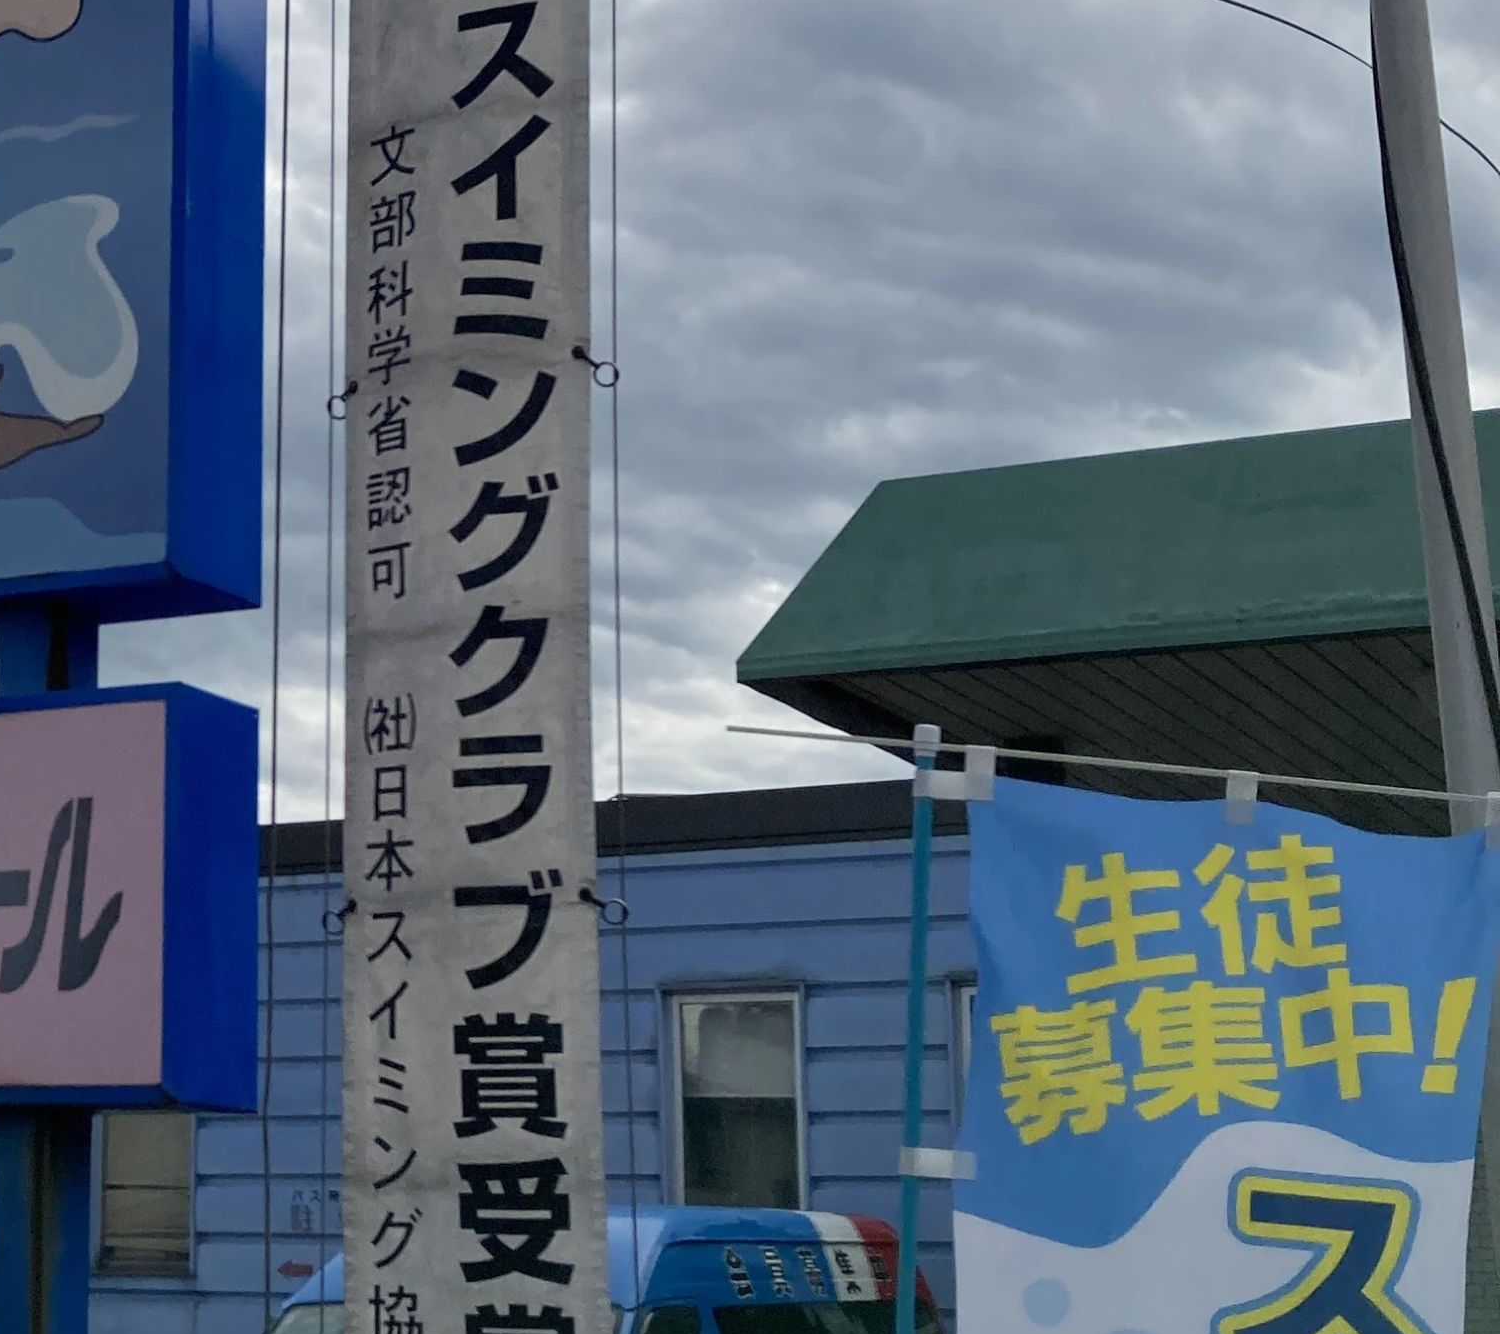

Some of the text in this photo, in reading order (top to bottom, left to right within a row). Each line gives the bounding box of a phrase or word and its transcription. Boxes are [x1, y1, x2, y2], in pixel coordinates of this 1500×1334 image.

[366, 124, 417, 600] 文部科学省認可
[1055, 834, 1348, 995] 生徒
[990, 968, 1478, 1146] 募集中!
